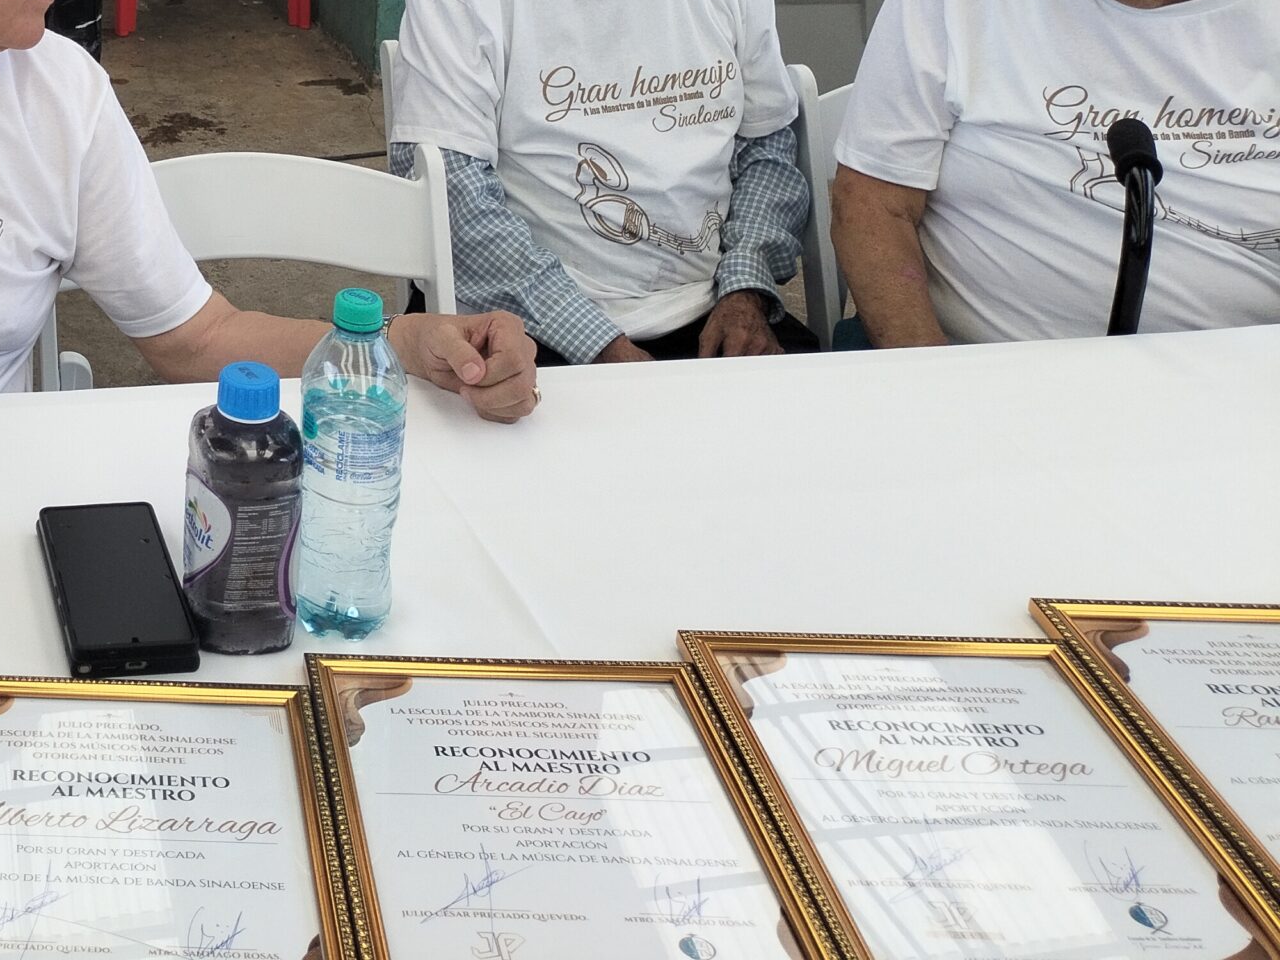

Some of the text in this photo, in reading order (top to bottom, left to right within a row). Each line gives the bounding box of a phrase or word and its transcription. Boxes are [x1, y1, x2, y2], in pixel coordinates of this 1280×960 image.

[539, 66, 623, 123] Gran
[583, 108, 589, 117] A
[590, 106, 600, 115] los
[601, 102, 635, 114] Maestros
[652, 104, 736, 132] Sinaloense
[1182, 130, 1213, 140] Música
[1215, 132, 1226, 140] de
[1228, 129, 1256, 139] Banda
[462, 700, 567, 710] JULIO PRECIADO,
[447, 728, 601, 740] OTORGAN EL SIGUIENTE
[827, 720, 1045, 736] RECONOCIMIENTO
[878, 734, 1019, 748] AL MAESTRO
[434, 745, 651, 763] RECONOCIMIENTO
[479, 761, 621, 775] AL MAESTRO
[814, 747, 1094, 782] Miguel Ortega
[12, 769, 231, 789] RECONOCIMIENTO
[434, 771, 570, 794] Arcadio
[51, 785, 196, 802] AL MAESTRO
[95, 805, 283, 841] Lizarraga
[462, 823, 652, 838] POR SU GRAN Y DESTACADA
[515, 839, 609, 849] APORTACIÓN
